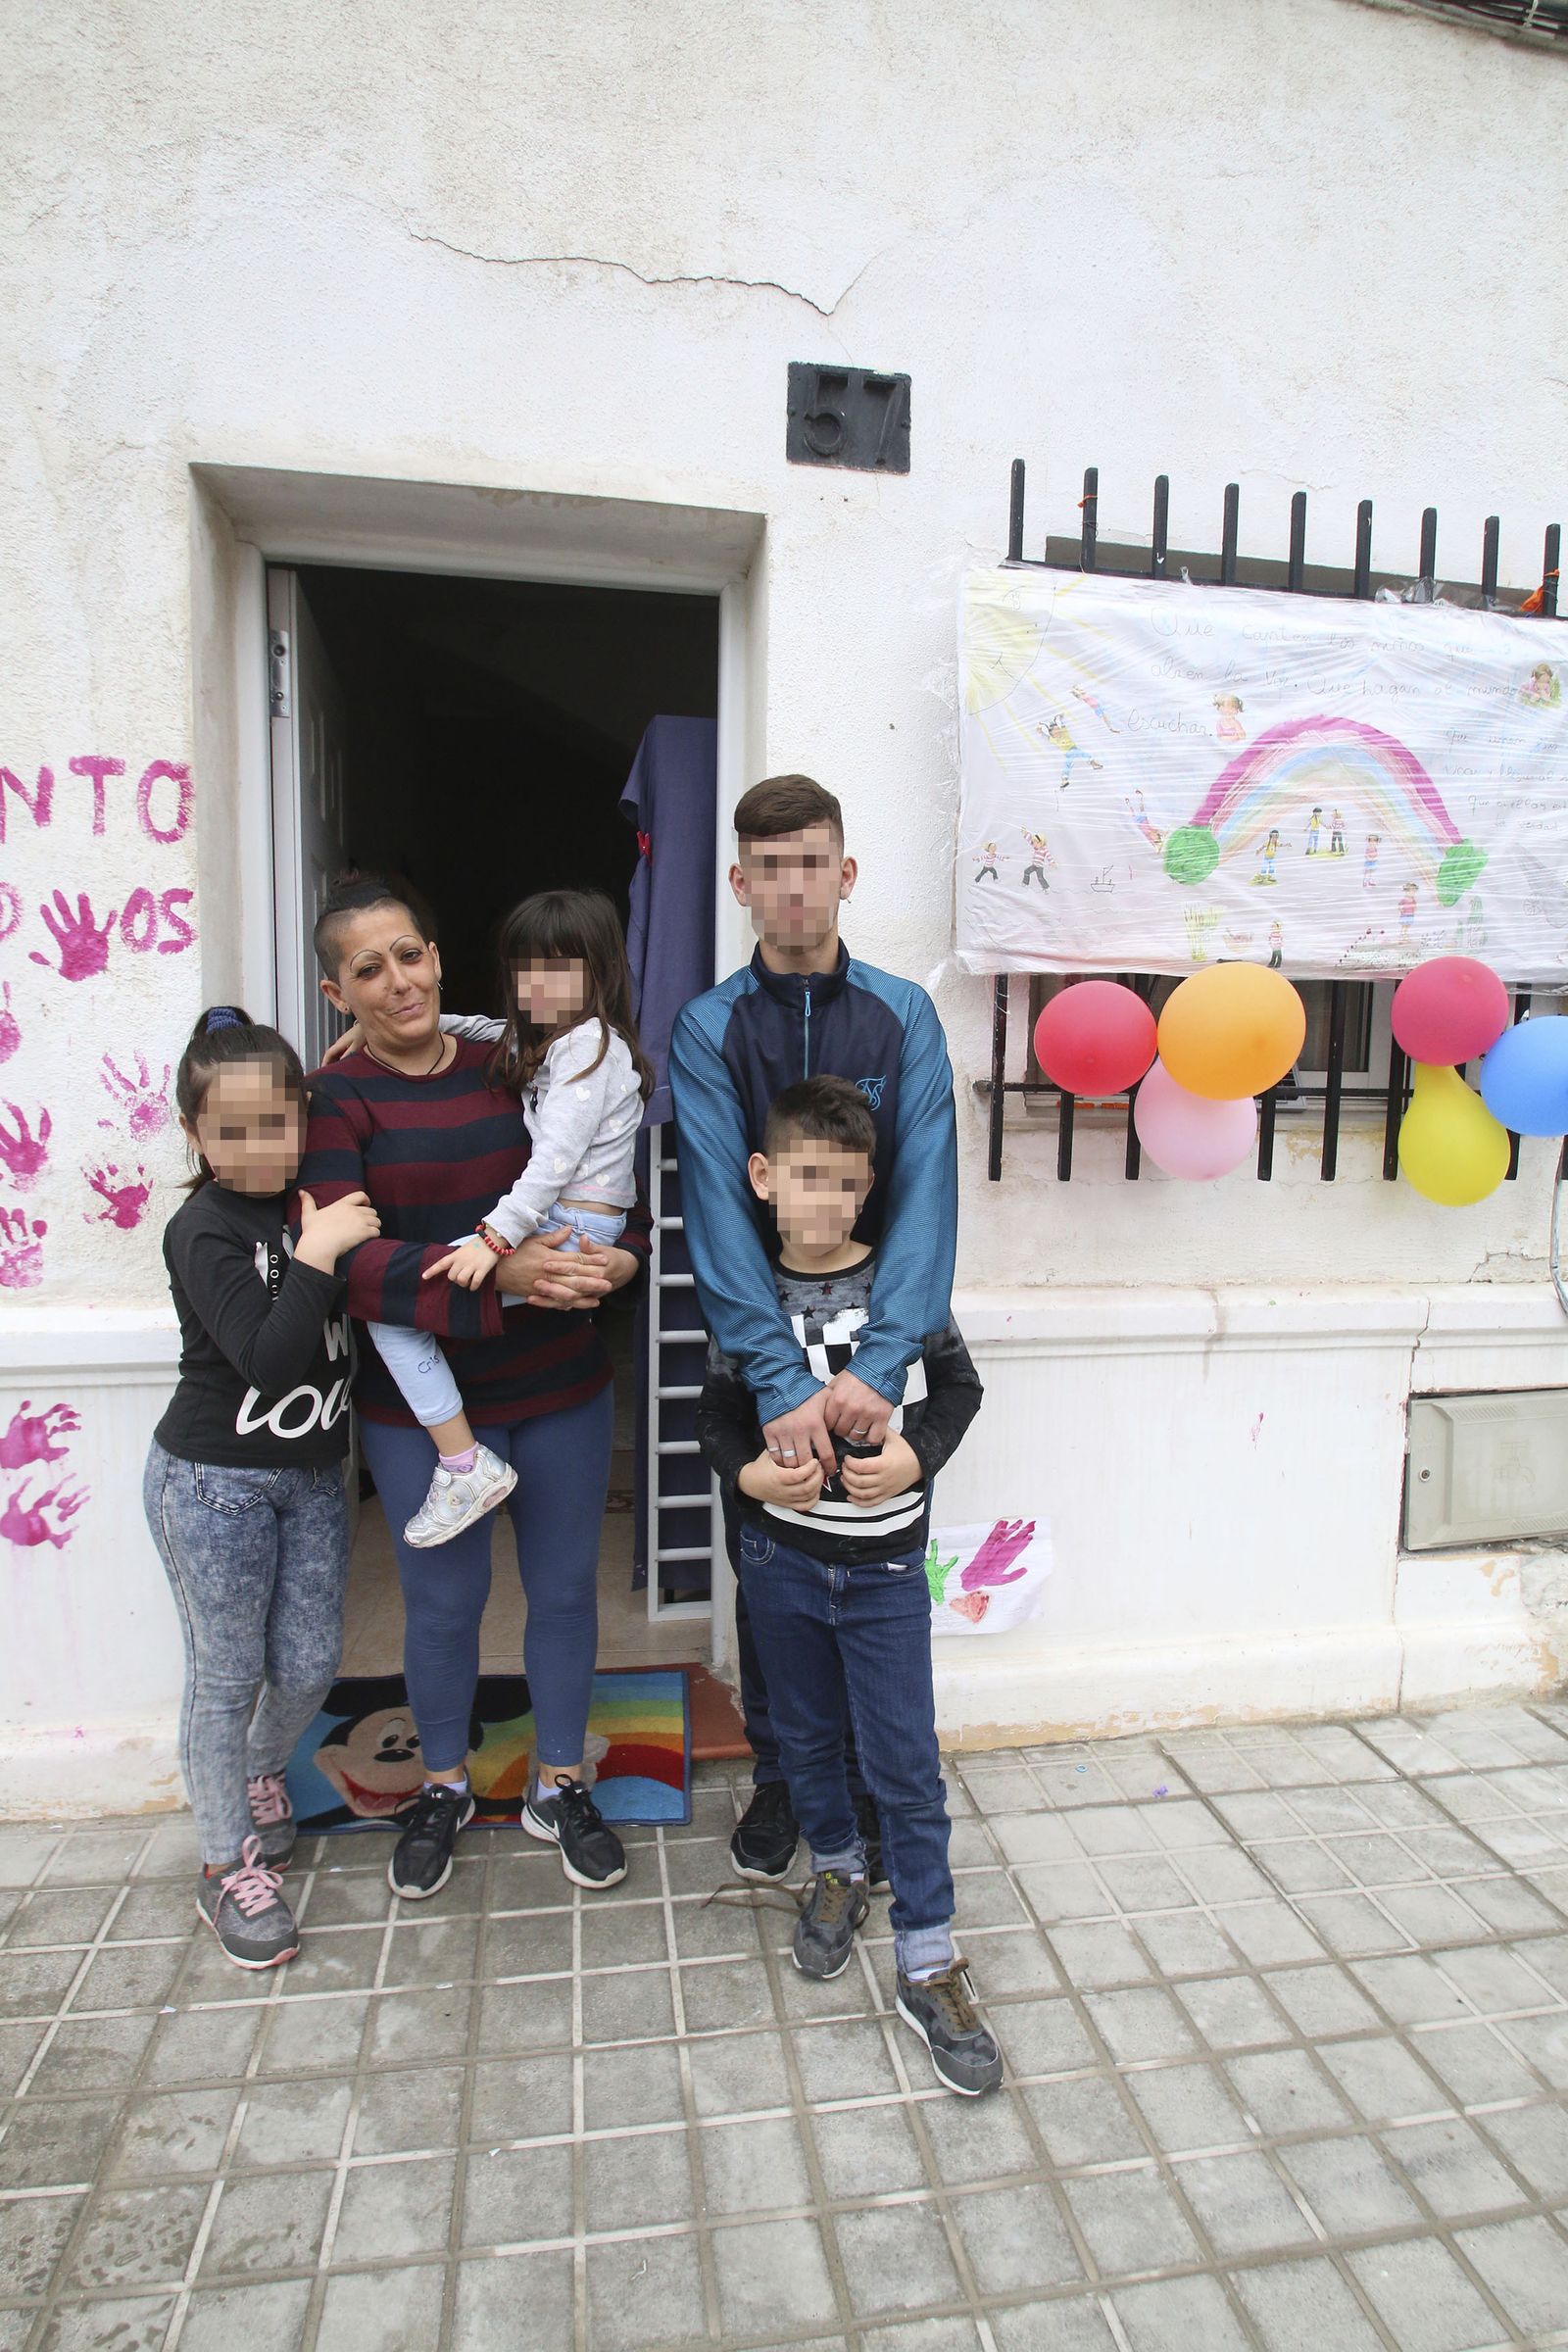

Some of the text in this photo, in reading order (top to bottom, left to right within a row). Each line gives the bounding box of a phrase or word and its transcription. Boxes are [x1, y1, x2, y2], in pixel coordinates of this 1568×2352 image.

[1152, 607, 1215, 637] Que
[1362, 679, 1421, 704] hagan
[0, 756, 196, 844] NTO
